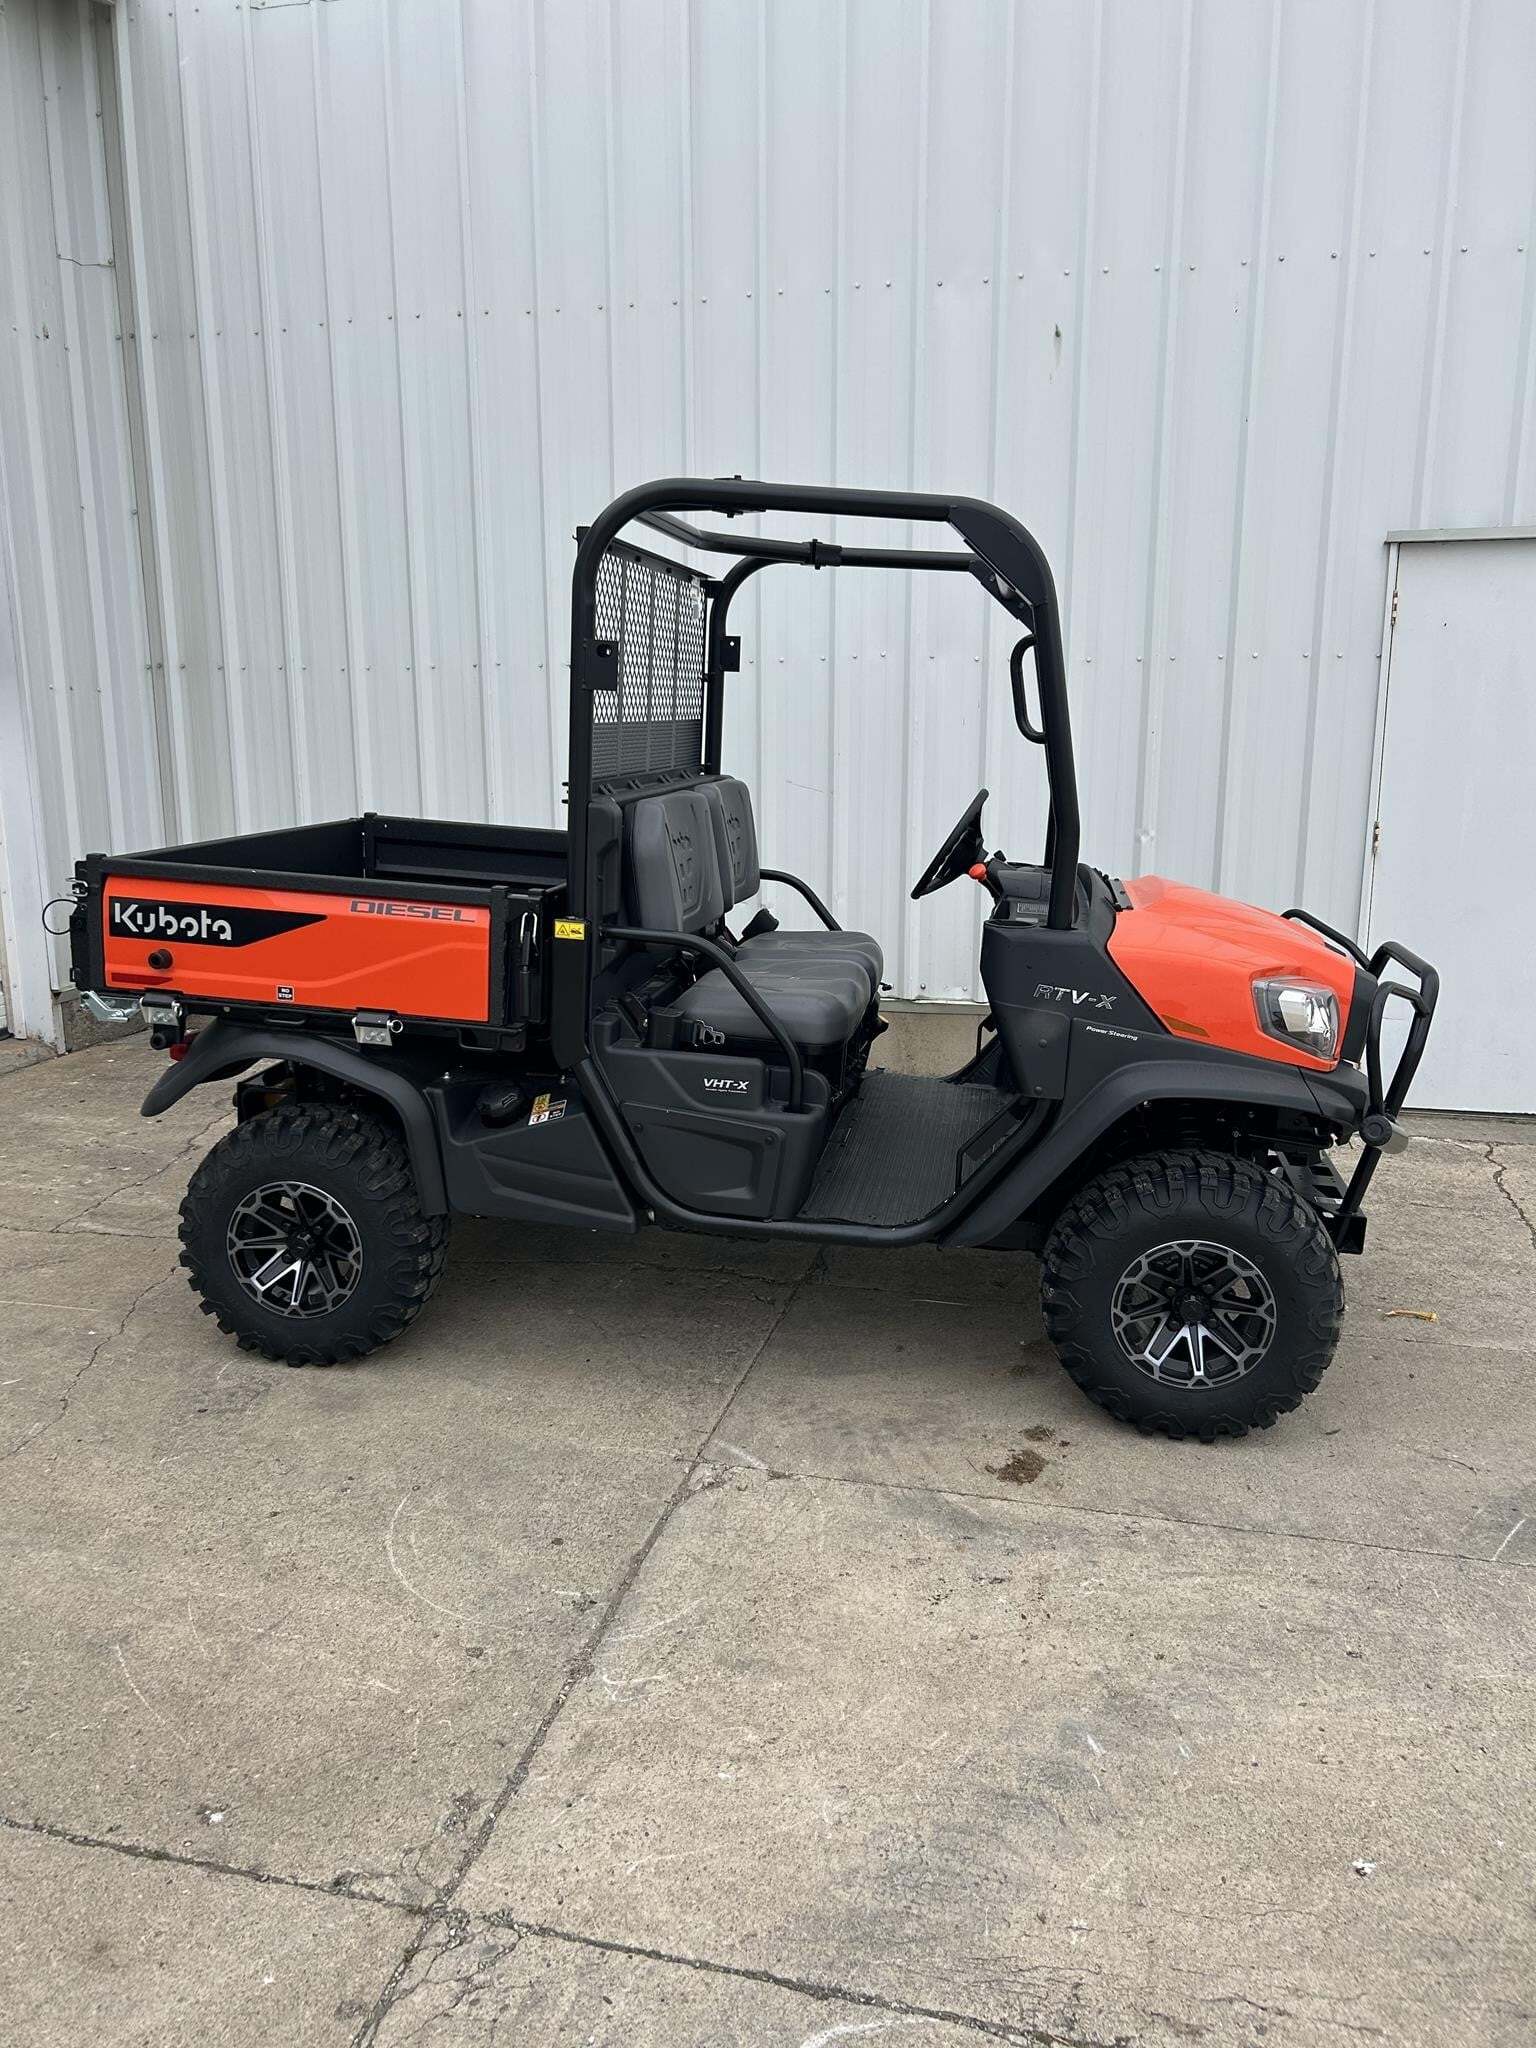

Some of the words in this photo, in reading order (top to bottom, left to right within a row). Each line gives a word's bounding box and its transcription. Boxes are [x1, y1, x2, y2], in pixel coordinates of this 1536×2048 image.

[114, 902, 232, 940] Kubota
[350, 899, 475, 922] DIESEL
[1033, 983, 1117, 1009] RTV-X
[1086, 1025, 1107, 1035] Power
[1107, 1030, 1138, 1041] Steering
[703, 1078, 749, 1089] VHT-X
